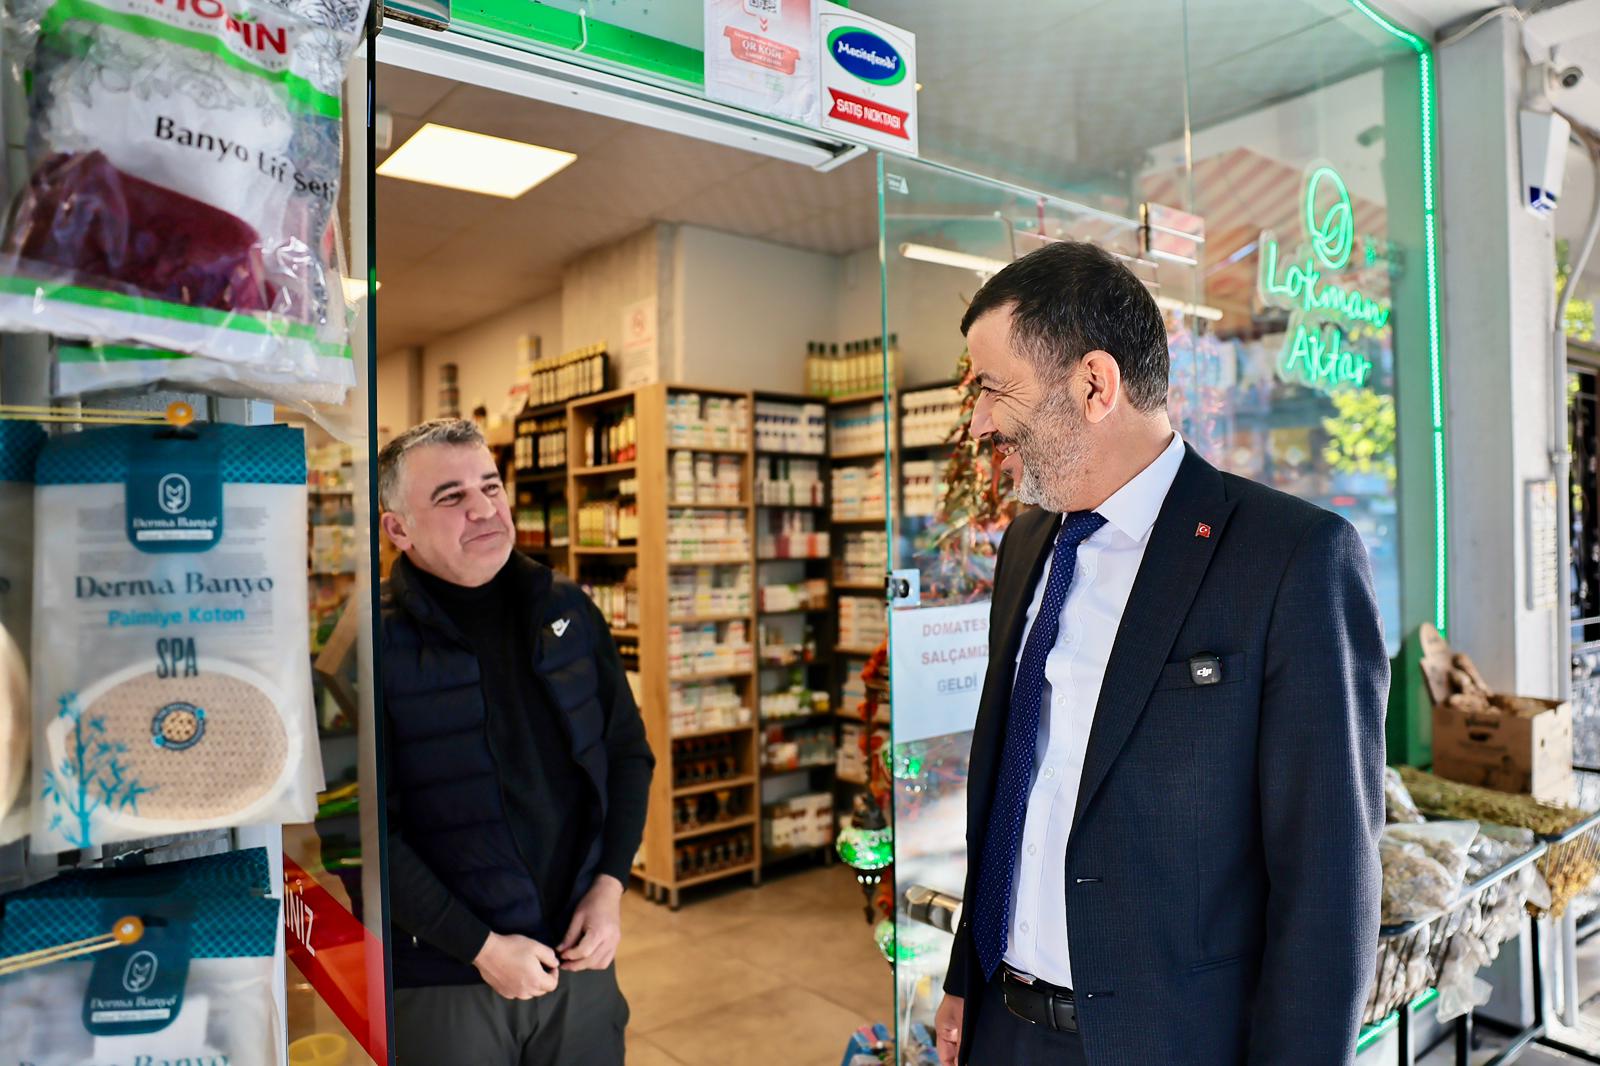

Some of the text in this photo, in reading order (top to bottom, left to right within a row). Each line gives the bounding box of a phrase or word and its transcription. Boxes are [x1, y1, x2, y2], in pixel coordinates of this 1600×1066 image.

[836, 98, 901, 129] SATIŞ NOKTASI
[154, 115, 336, 201] Banyo Lif Seti
[1266, 241, 1390, 328] Lokman
[1285, 323, 1372, 388] Aktar
[75, 571, 274, 598] Derma Banyo
[188, 607, 245, 624] Koton
[922, 618, 987, 637] DOMATES
[156, 637, 199, 679] SPA
[921, 644, 989, 665] SALÇAMIZ
[937, 672, 977, 693] GELDİ
